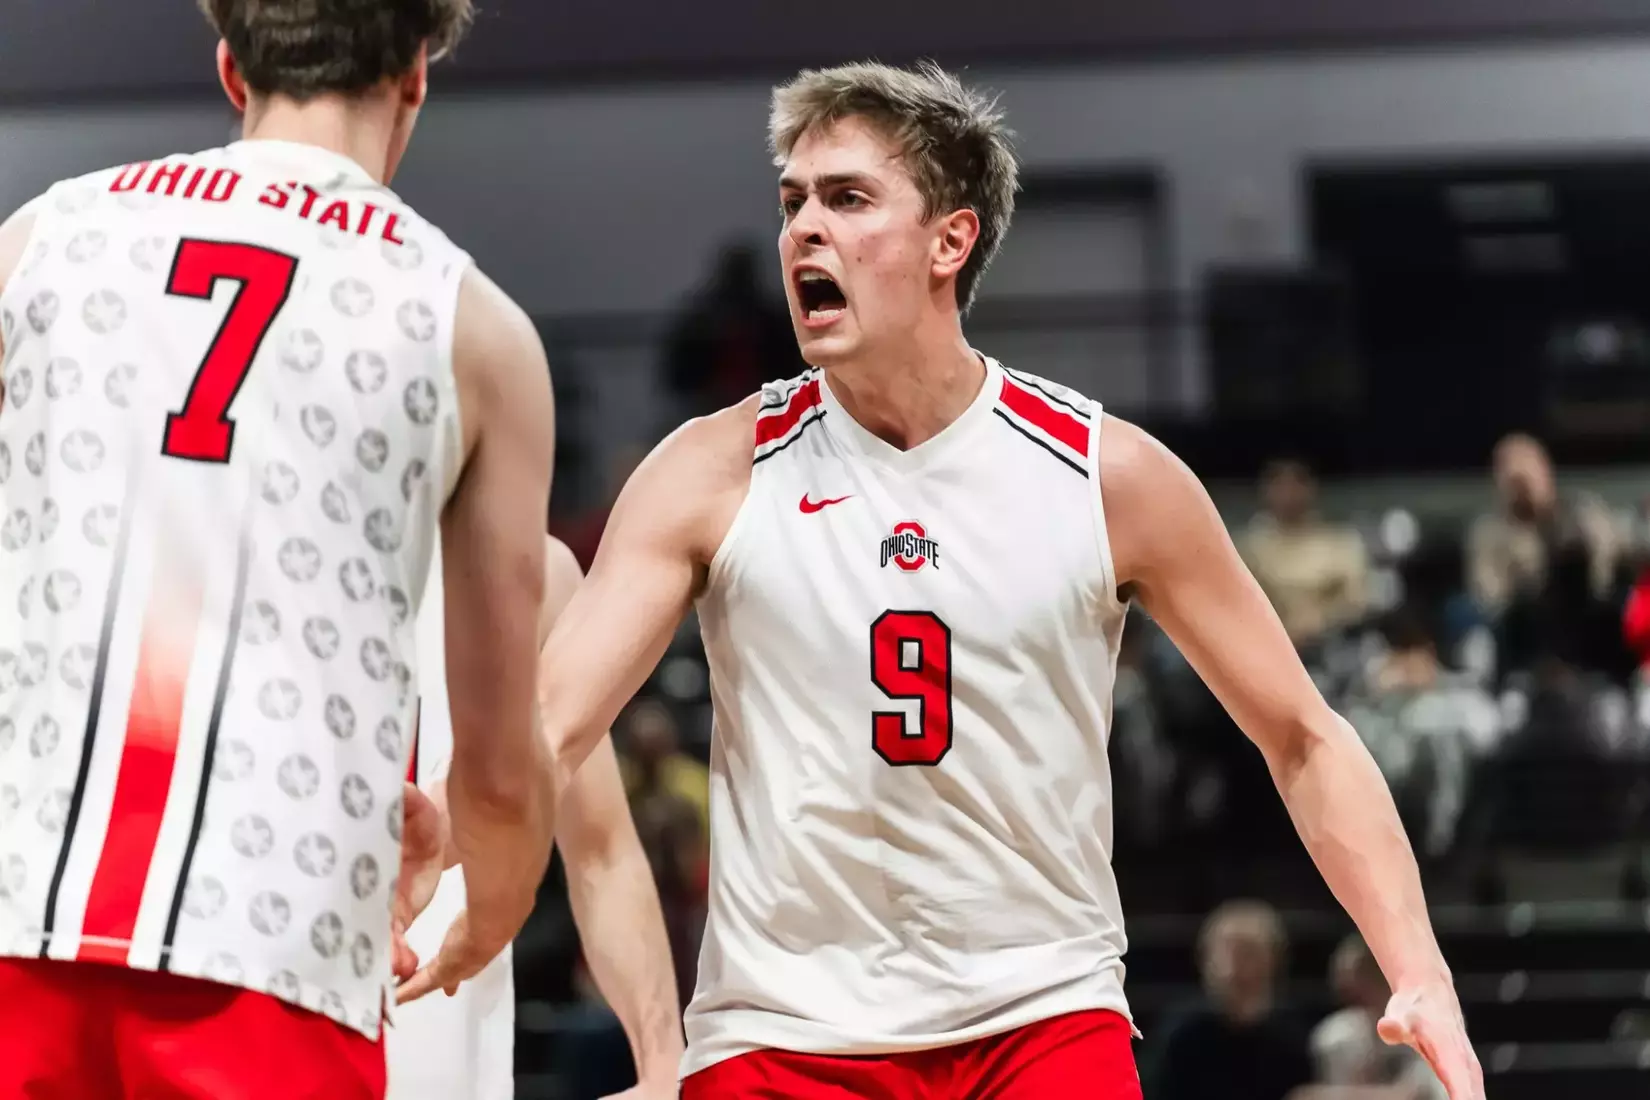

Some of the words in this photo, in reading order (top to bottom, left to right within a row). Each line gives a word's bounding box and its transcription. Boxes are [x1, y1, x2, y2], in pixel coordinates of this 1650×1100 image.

[109, 160, 242, 202] OHIO
[161, 237, 299, 464] 7
[870, 609, 953, 767] 9
